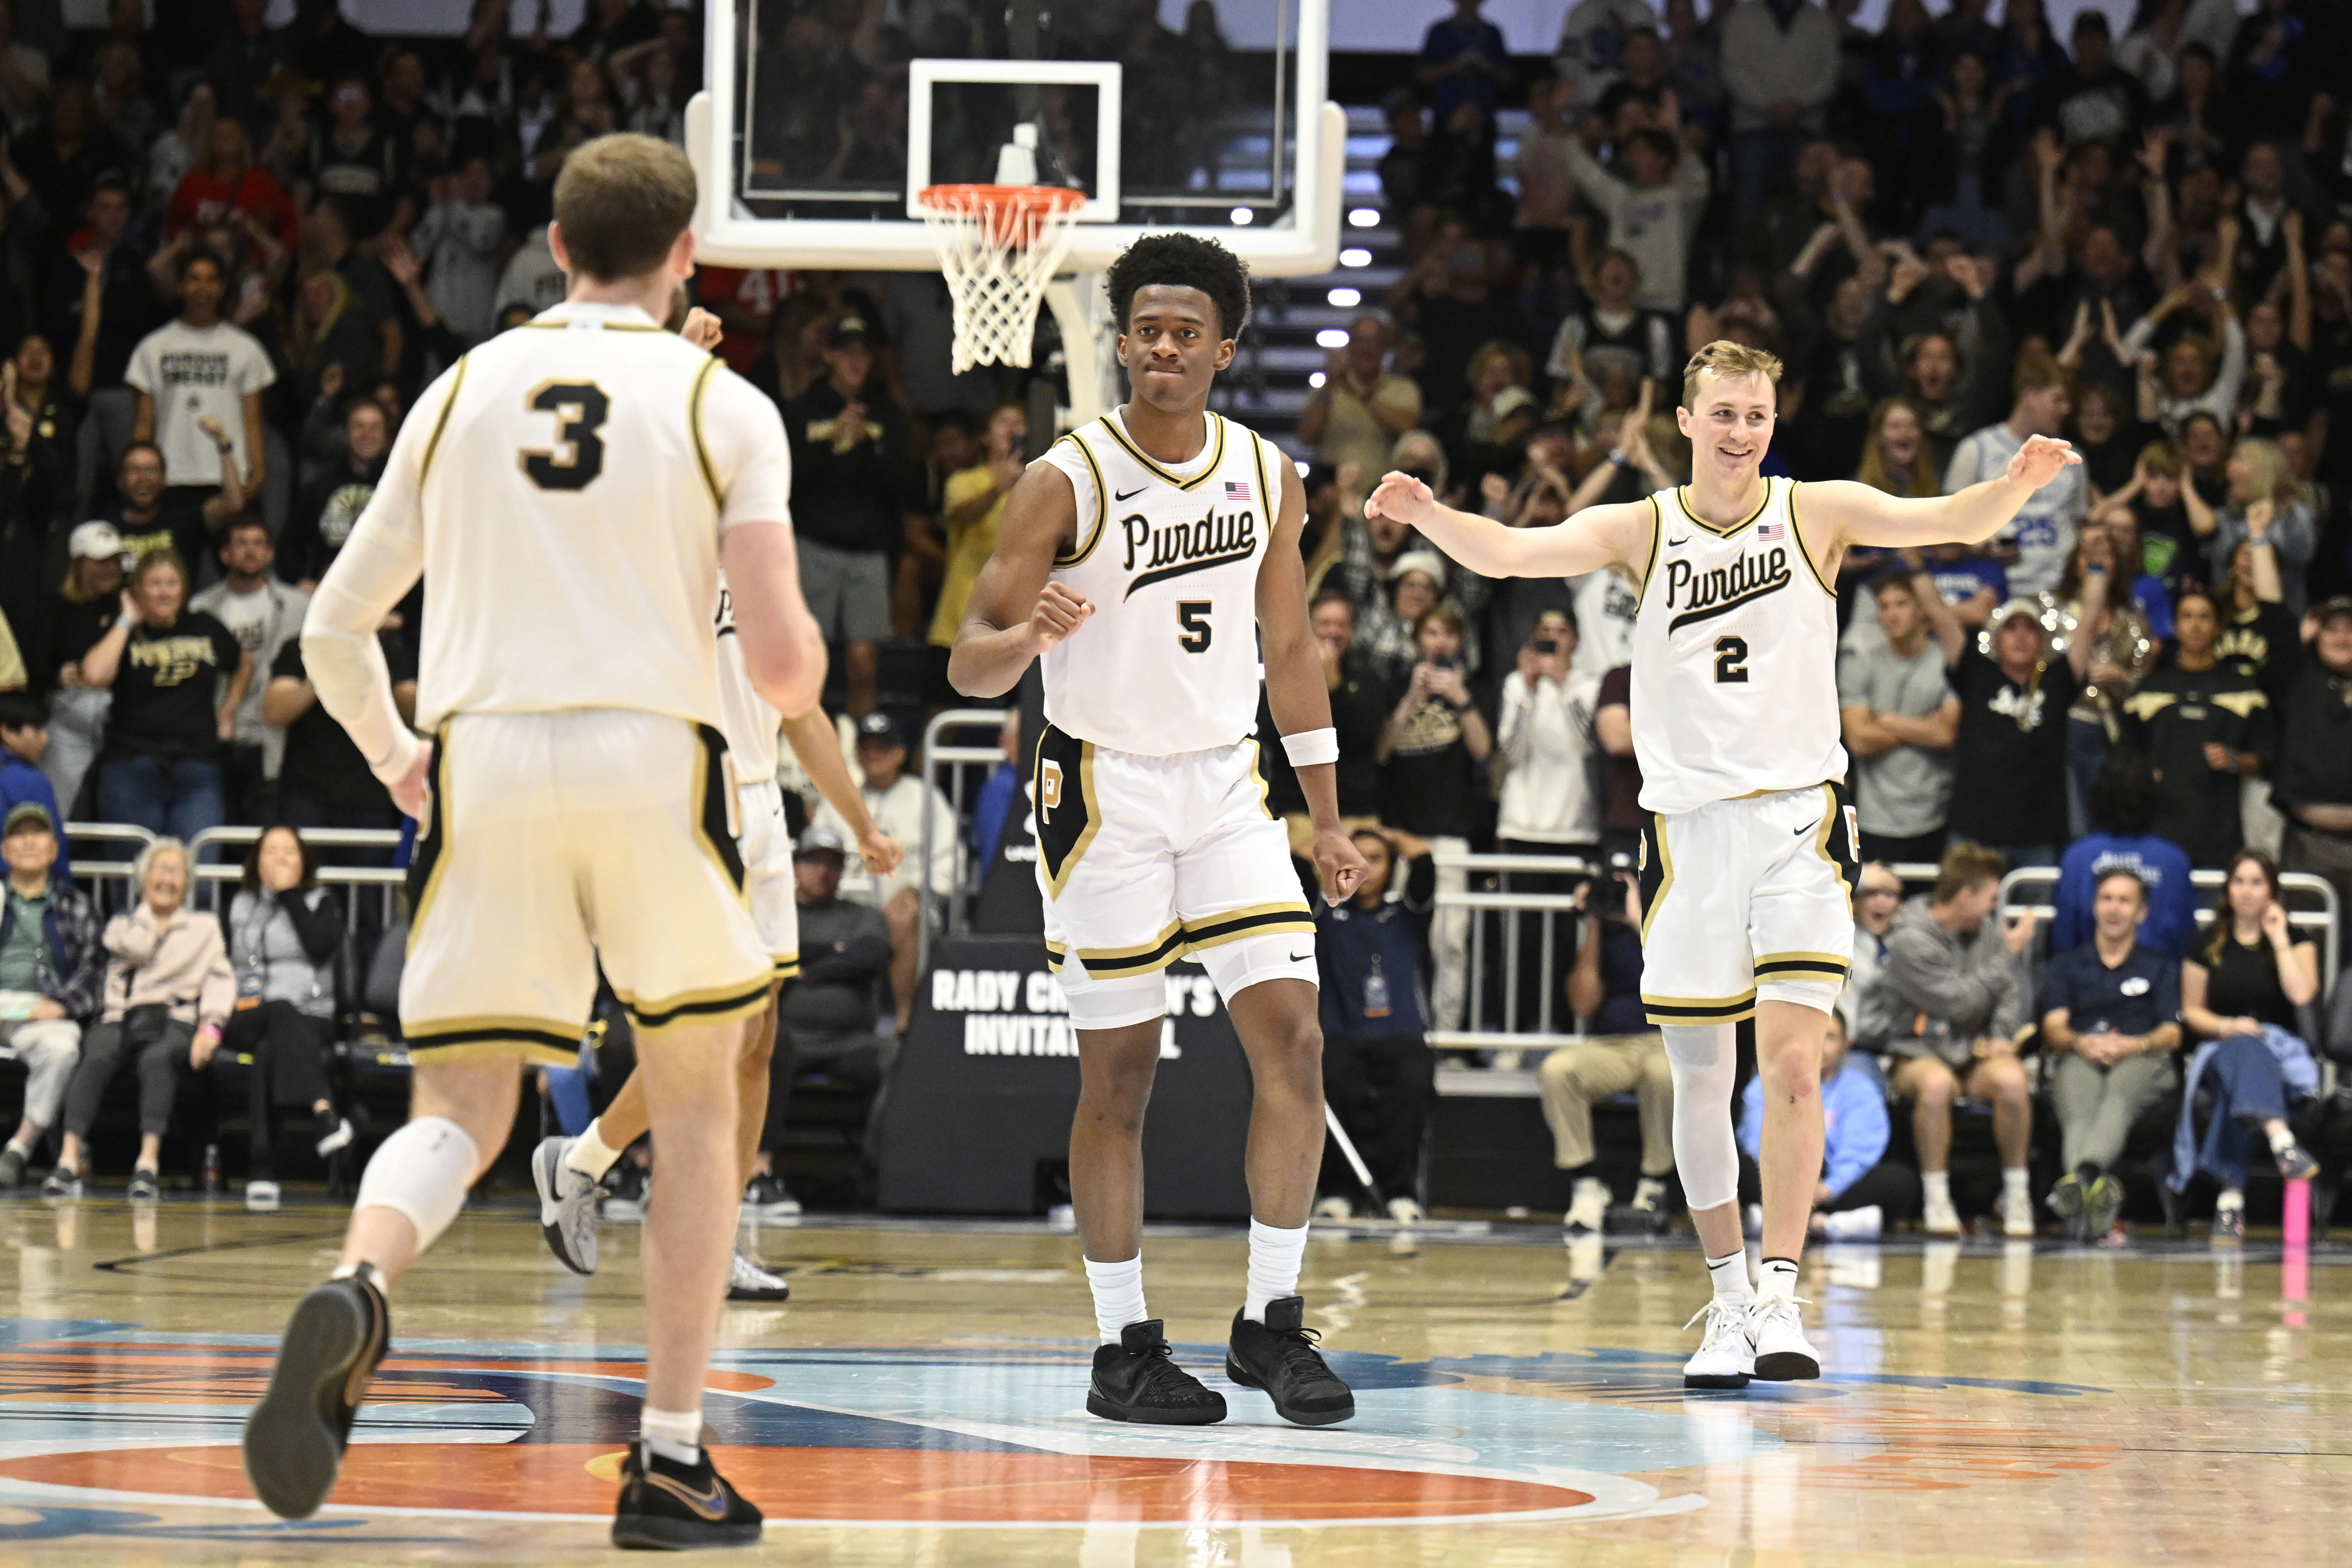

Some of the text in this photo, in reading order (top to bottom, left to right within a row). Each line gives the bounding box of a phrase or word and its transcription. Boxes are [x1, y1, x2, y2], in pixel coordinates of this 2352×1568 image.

[517, 379, 610, 492] 3
[1119, 504, 1256, 572] Purdue
[2017, 515, 2058, 547] 25
[1665, 547, 1792, 610] Purdue
[1176, 600, 1212, 654] 5
[1713, 635, 1748, 683] 2
[1042, 758, 1063, 824] P
[932, 969, 1217, 1017] RADY CHN'S
